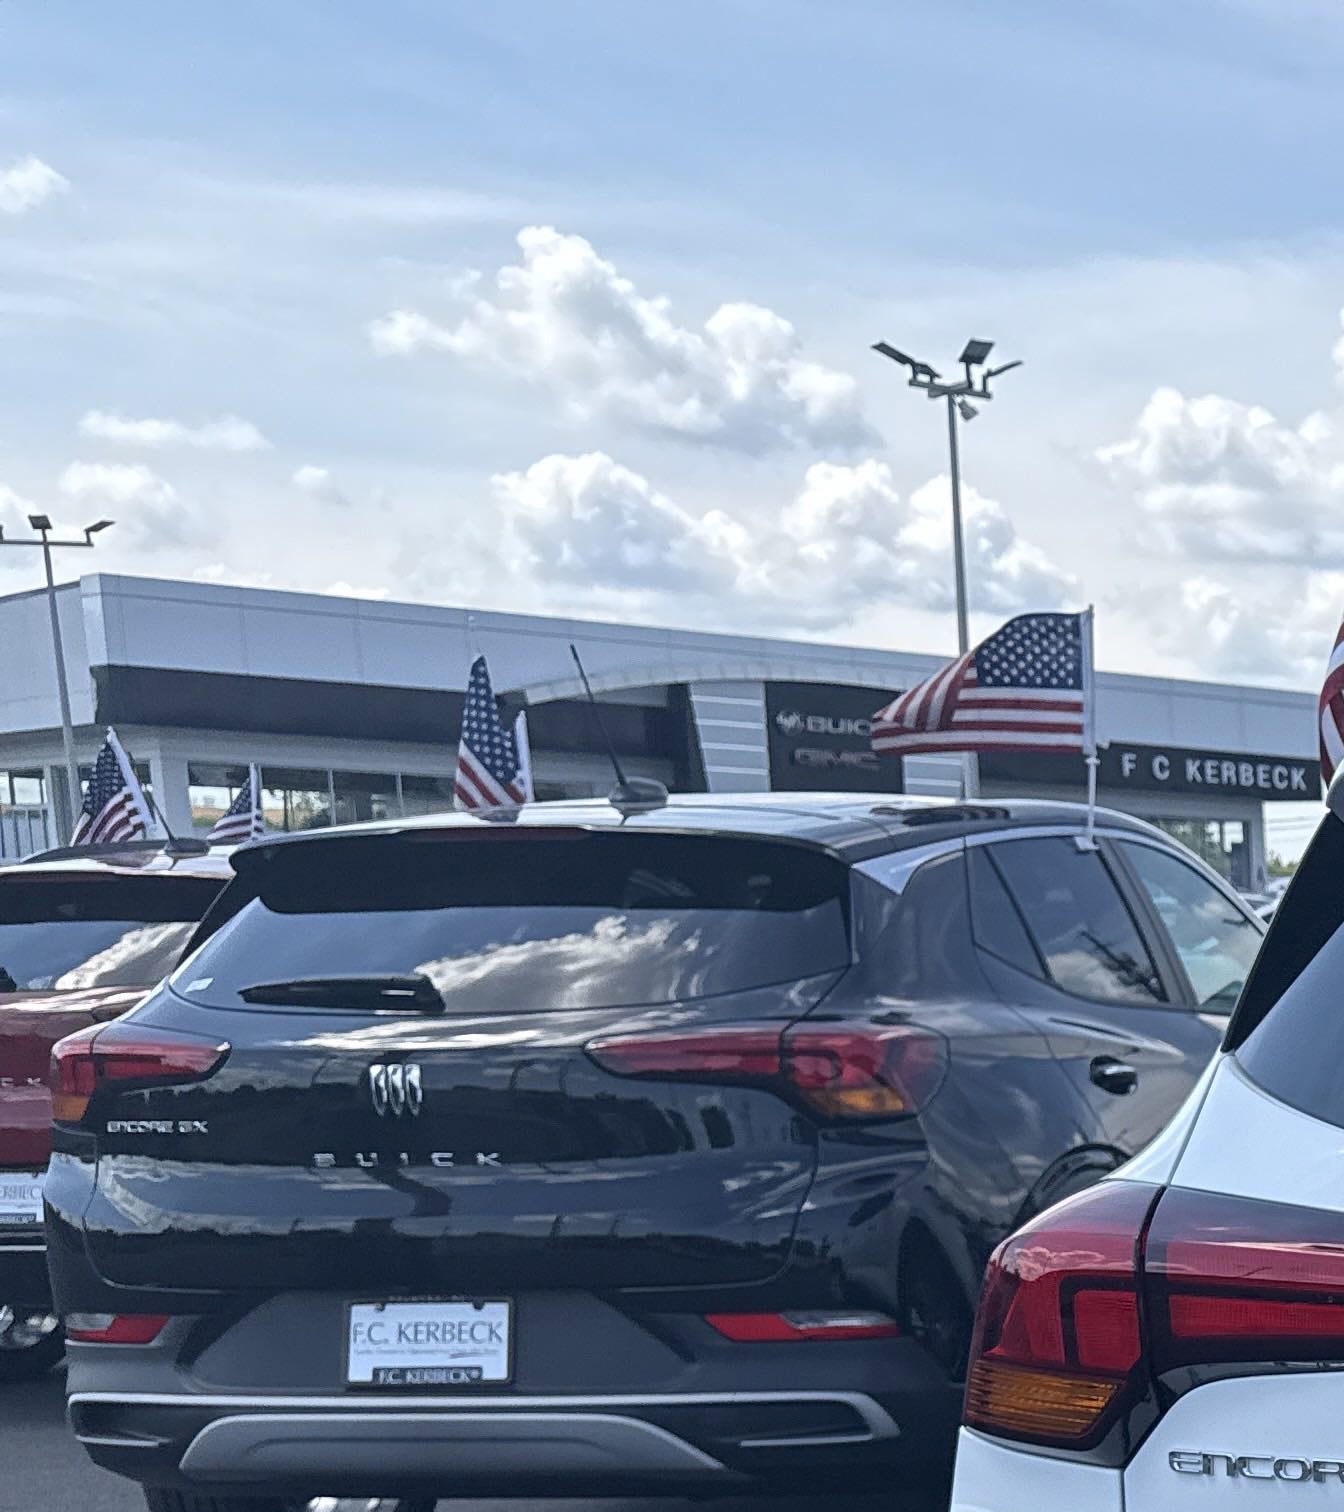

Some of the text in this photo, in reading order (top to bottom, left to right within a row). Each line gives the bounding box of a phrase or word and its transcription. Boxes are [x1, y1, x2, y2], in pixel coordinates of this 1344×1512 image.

[806, 715, 873, 736] BUIC
[1121, 752, 1307, 791] F C KERBECK
[314, 1152, 501, 1167] BUICK
[352, 1321, 503, 1345] F.C. KERBECK
